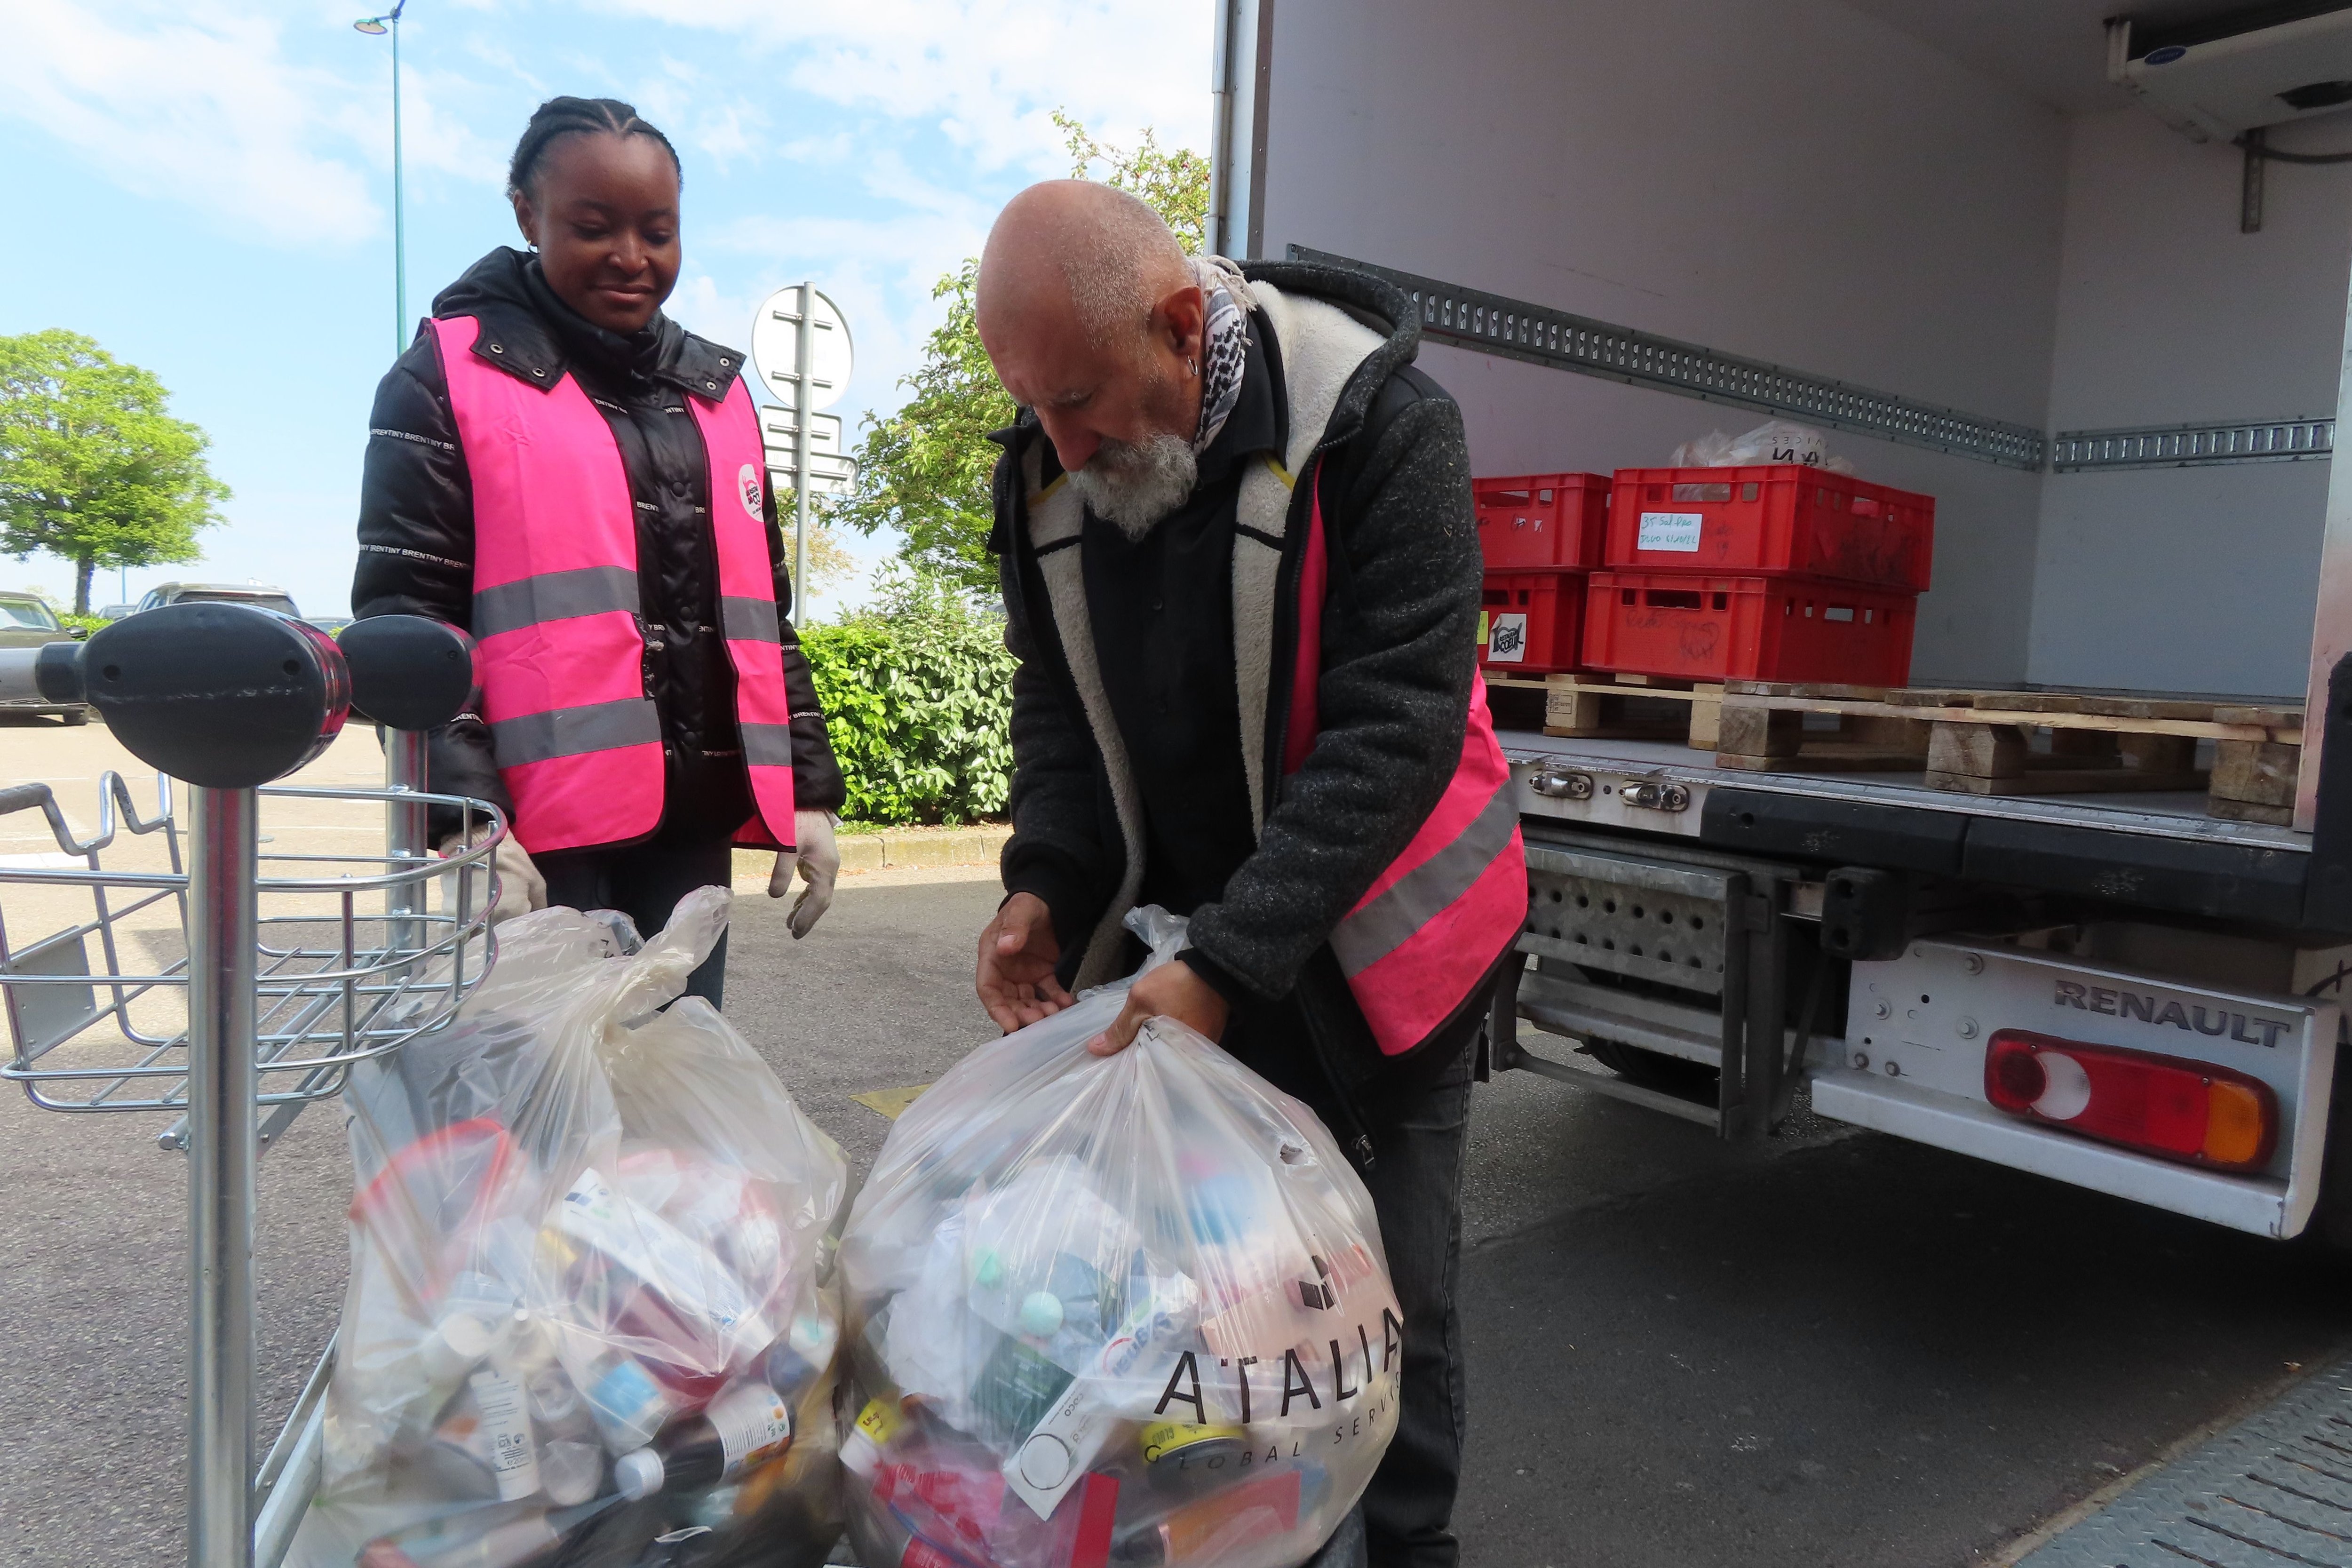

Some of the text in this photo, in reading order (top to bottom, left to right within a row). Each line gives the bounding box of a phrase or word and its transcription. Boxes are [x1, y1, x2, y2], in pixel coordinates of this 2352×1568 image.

[404, 432, 442, 448] BRENTINY
[1772, 436, 1822, 445] VICES
[636, 501, 659, 512] BRENT
[402, 549, 443, 563] BRENTINY
[444, 559, 467, 568] BREN
[2055, 980, 2290, 1048] RENAULT
[1153, 1306, 1403, 1425] ATALIA
[1144, 1441, 1301, 1470] GLOBAL
